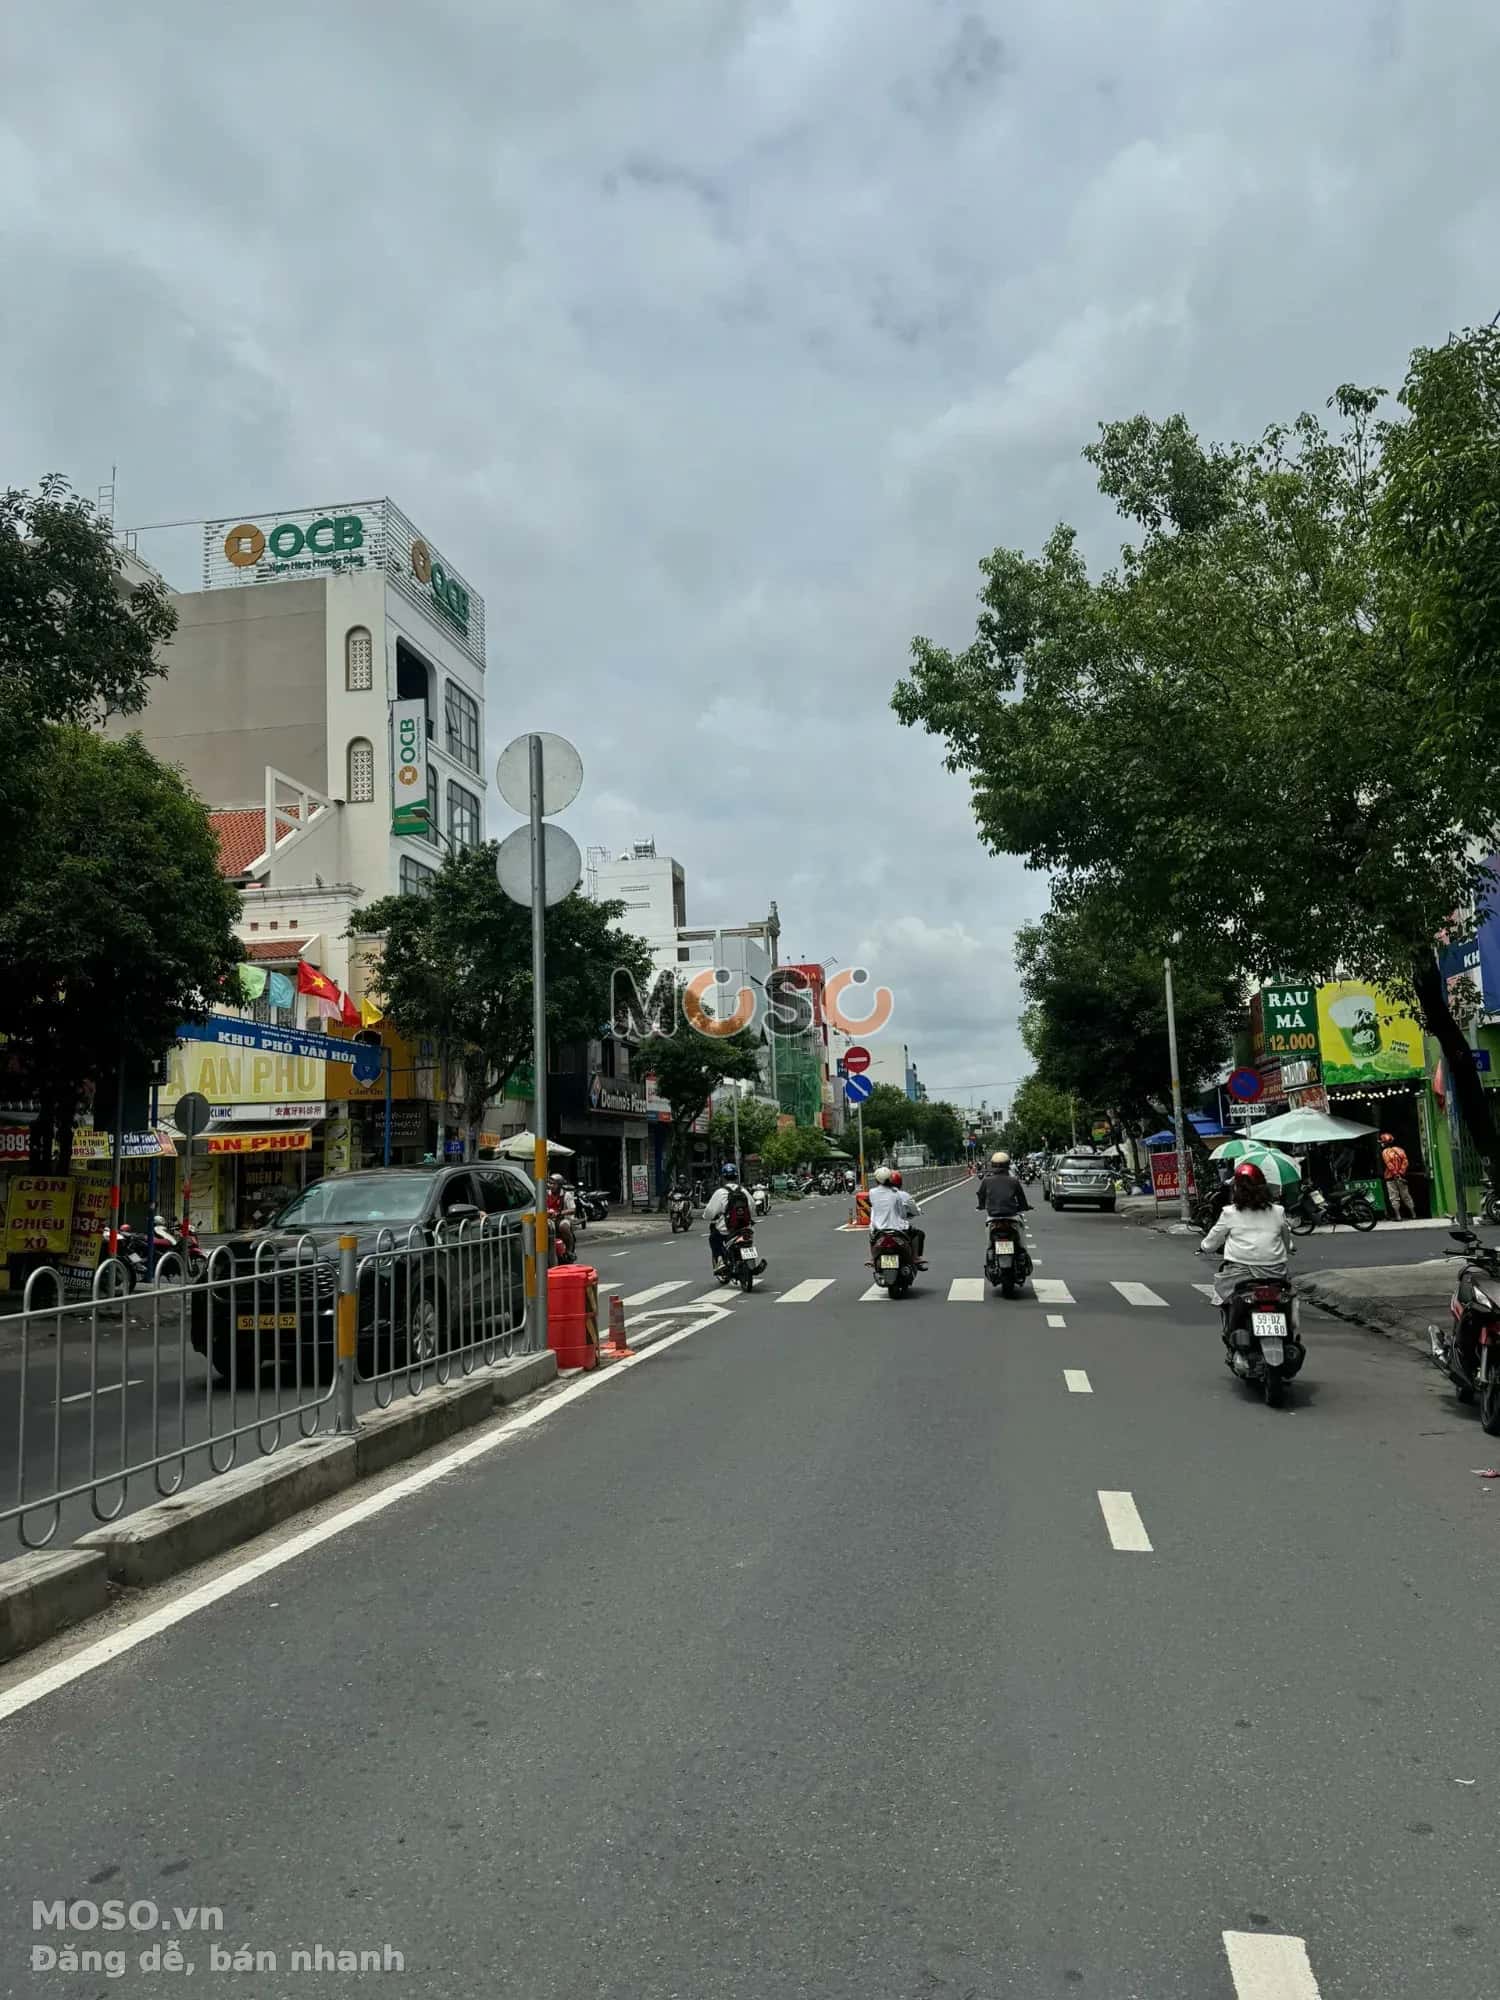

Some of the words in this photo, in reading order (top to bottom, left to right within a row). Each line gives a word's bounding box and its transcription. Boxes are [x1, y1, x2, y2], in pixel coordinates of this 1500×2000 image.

[269, 516, 364, 558] OCB
[431, 562, 469, 624] OCB
[400, 719, 416, 763] OCB
[1267, 991, 1309, 1007] RAU
[1276, 1009, 1306, 1028] MÁ
[218, 1031, 256, 1047] KHU
[261, 1039, 293, 1053] PHỐ
[1270, 1033, 1315, 1050] 12.000
[199, 1057, 240, 1096] AN
[601, 1088, 630, 1110] Domino's
[210, 1106, 232, 1118] CLINIC
[208, 1138, 241, 1151] AN
